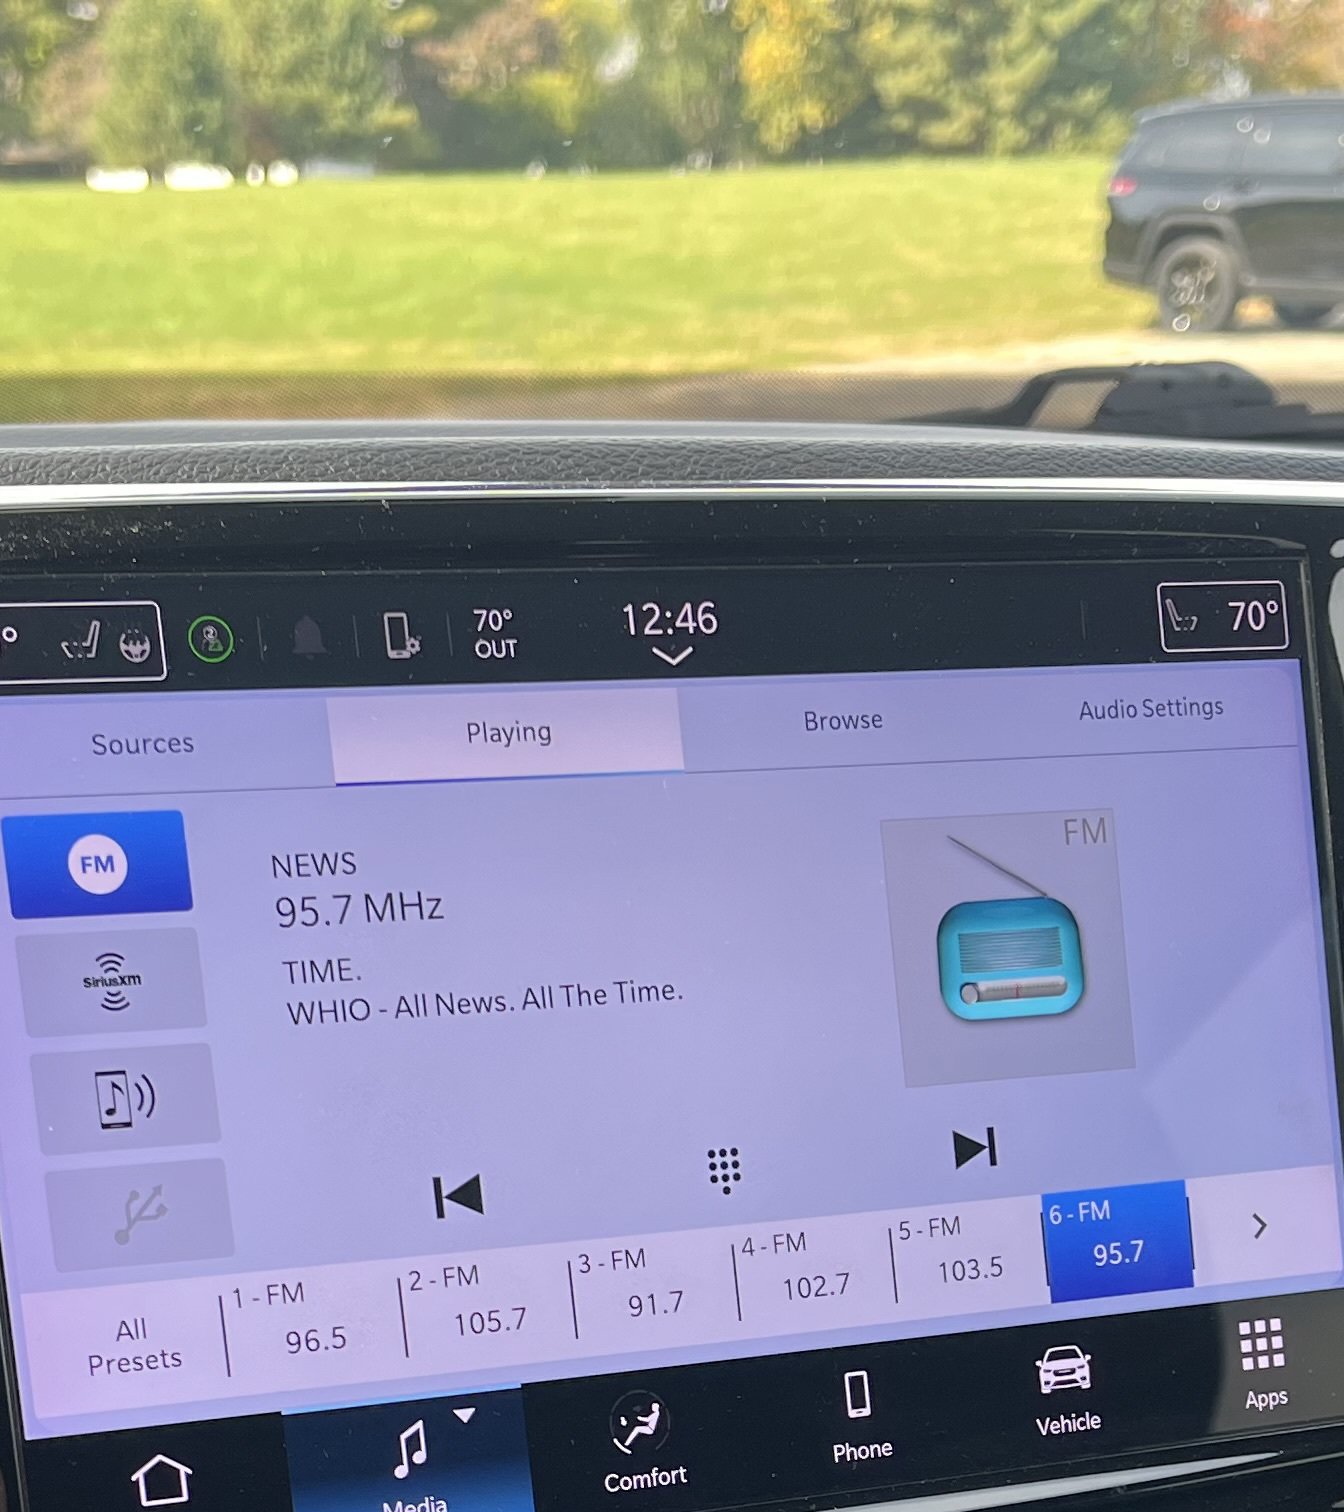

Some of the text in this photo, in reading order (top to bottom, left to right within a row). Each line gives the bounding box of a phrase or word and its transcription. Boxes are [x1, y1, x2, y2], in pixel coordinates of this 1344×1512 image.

[623, 602, 718, 636] 12:46
[475, 638, 517, 659] OUT
[804, 709, 883, 732] Browse
[1079, 696, 1224, 721] Audio Settings
[92, 732, 194, 756] Sources
[467, 720, 552, 747] Playing
[1064, 817, 1107, 846] FM
[80, 855, 115, 874] FM
[271, 852, 357, 879] NEWS
[275, 891, 444, 928] 95.7 MHz
[282, 958, 362, 984] TIME.
[288, 998, 371, 1026] WHIO
[394, 994, 428, 1019] All
[437, 989, 515, 1015] News.
[522, 986, 554, 1011] All
[560, 983, 607, 1008] The
[613, 979, 684, 1004] Time.
[1049, 1206, 1062, 1226] 6
[1079, 1200, 1111, 1223] FM
[899, 1222, 911, 1241] 5
[929, 1216, 962, 1239] FM
[741, 1237, 755, 1257] 4
[773, 1232, 807, 1255] FM
[1093, 1241, 1144, 1267] 95.7
[578, 1254, 592, 1274] 3
[611, 1248, 647, 1272] FM
[938, 1256, 1003, 1284] 103.5
[408, 1272, 422, 1292] 2
[443, 1266, 480, 1289] FM
[783, 1272, 850, 1300] 102.7
[232, 1287, 243, 1309] 1
[267, 1282, 305, 1306] FM
[628, 1290, 683, 1318] 91.7
[115, 1317, 147, 1341] All
[456, 1308, 527, 1337] 105.7
[286, 1327, 347, 1354] 96.5
[88, 1348, 182, 1376] Presets
[1245, 1388, 1288, 1412] Apps
[1036, 1412, 1101, 1437] Vehicle
[833, 1438, 893, 1462] Phone
[604, 1466, 687, 1493] Comfort
